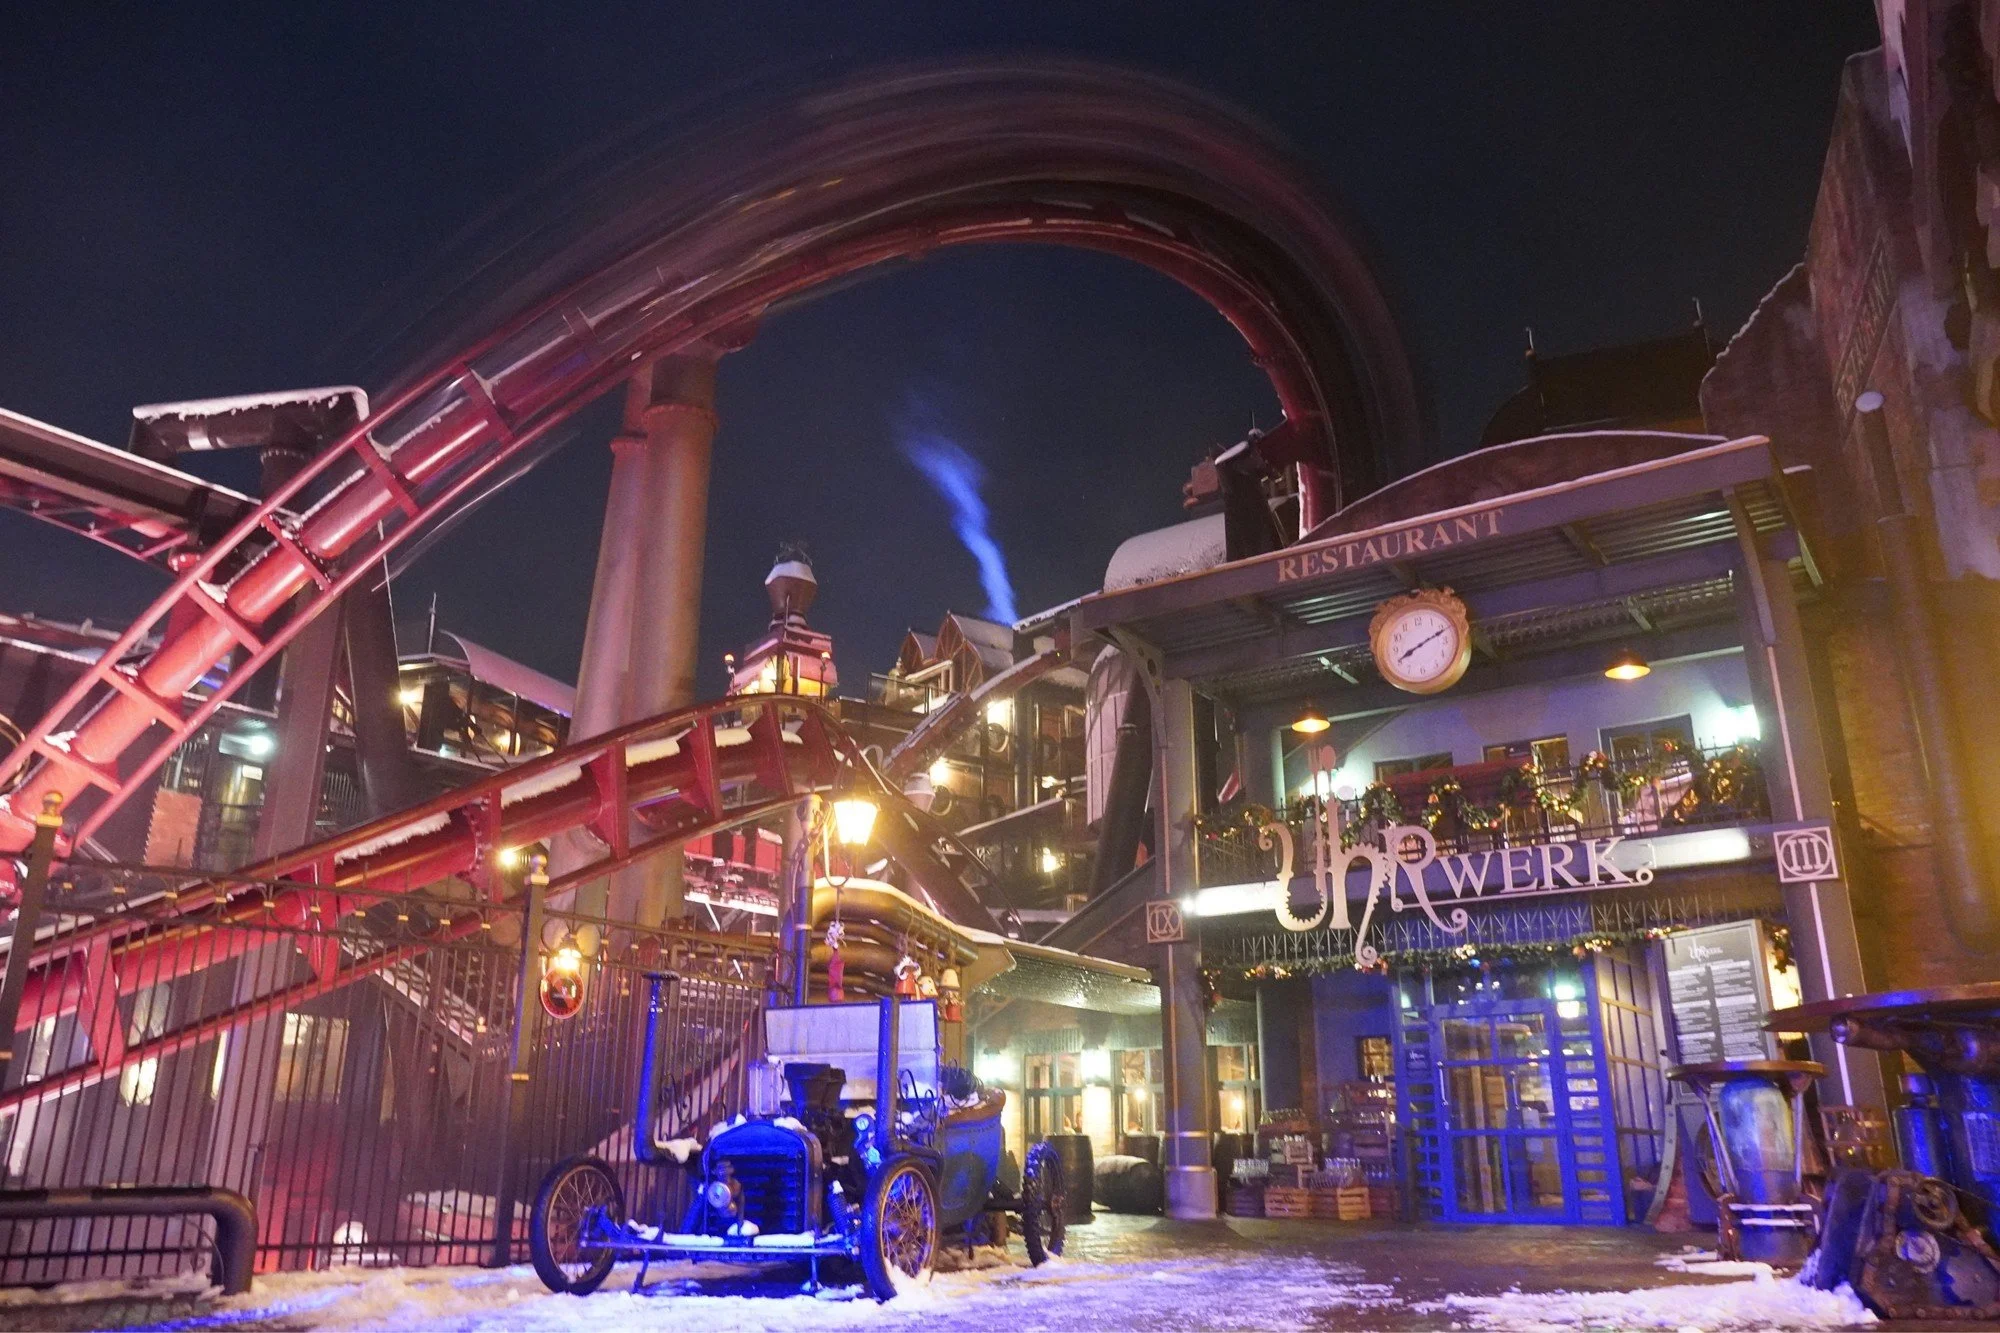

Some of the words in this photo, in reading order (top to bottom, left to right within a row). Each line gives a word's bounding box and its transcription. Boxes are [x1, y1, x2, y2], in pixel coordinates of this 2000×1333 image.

[1277, 510, 1504, 583] RESTAURANT
[1786, 837, 1824, 872] III
[1154, 907, 1176, 935] IX
